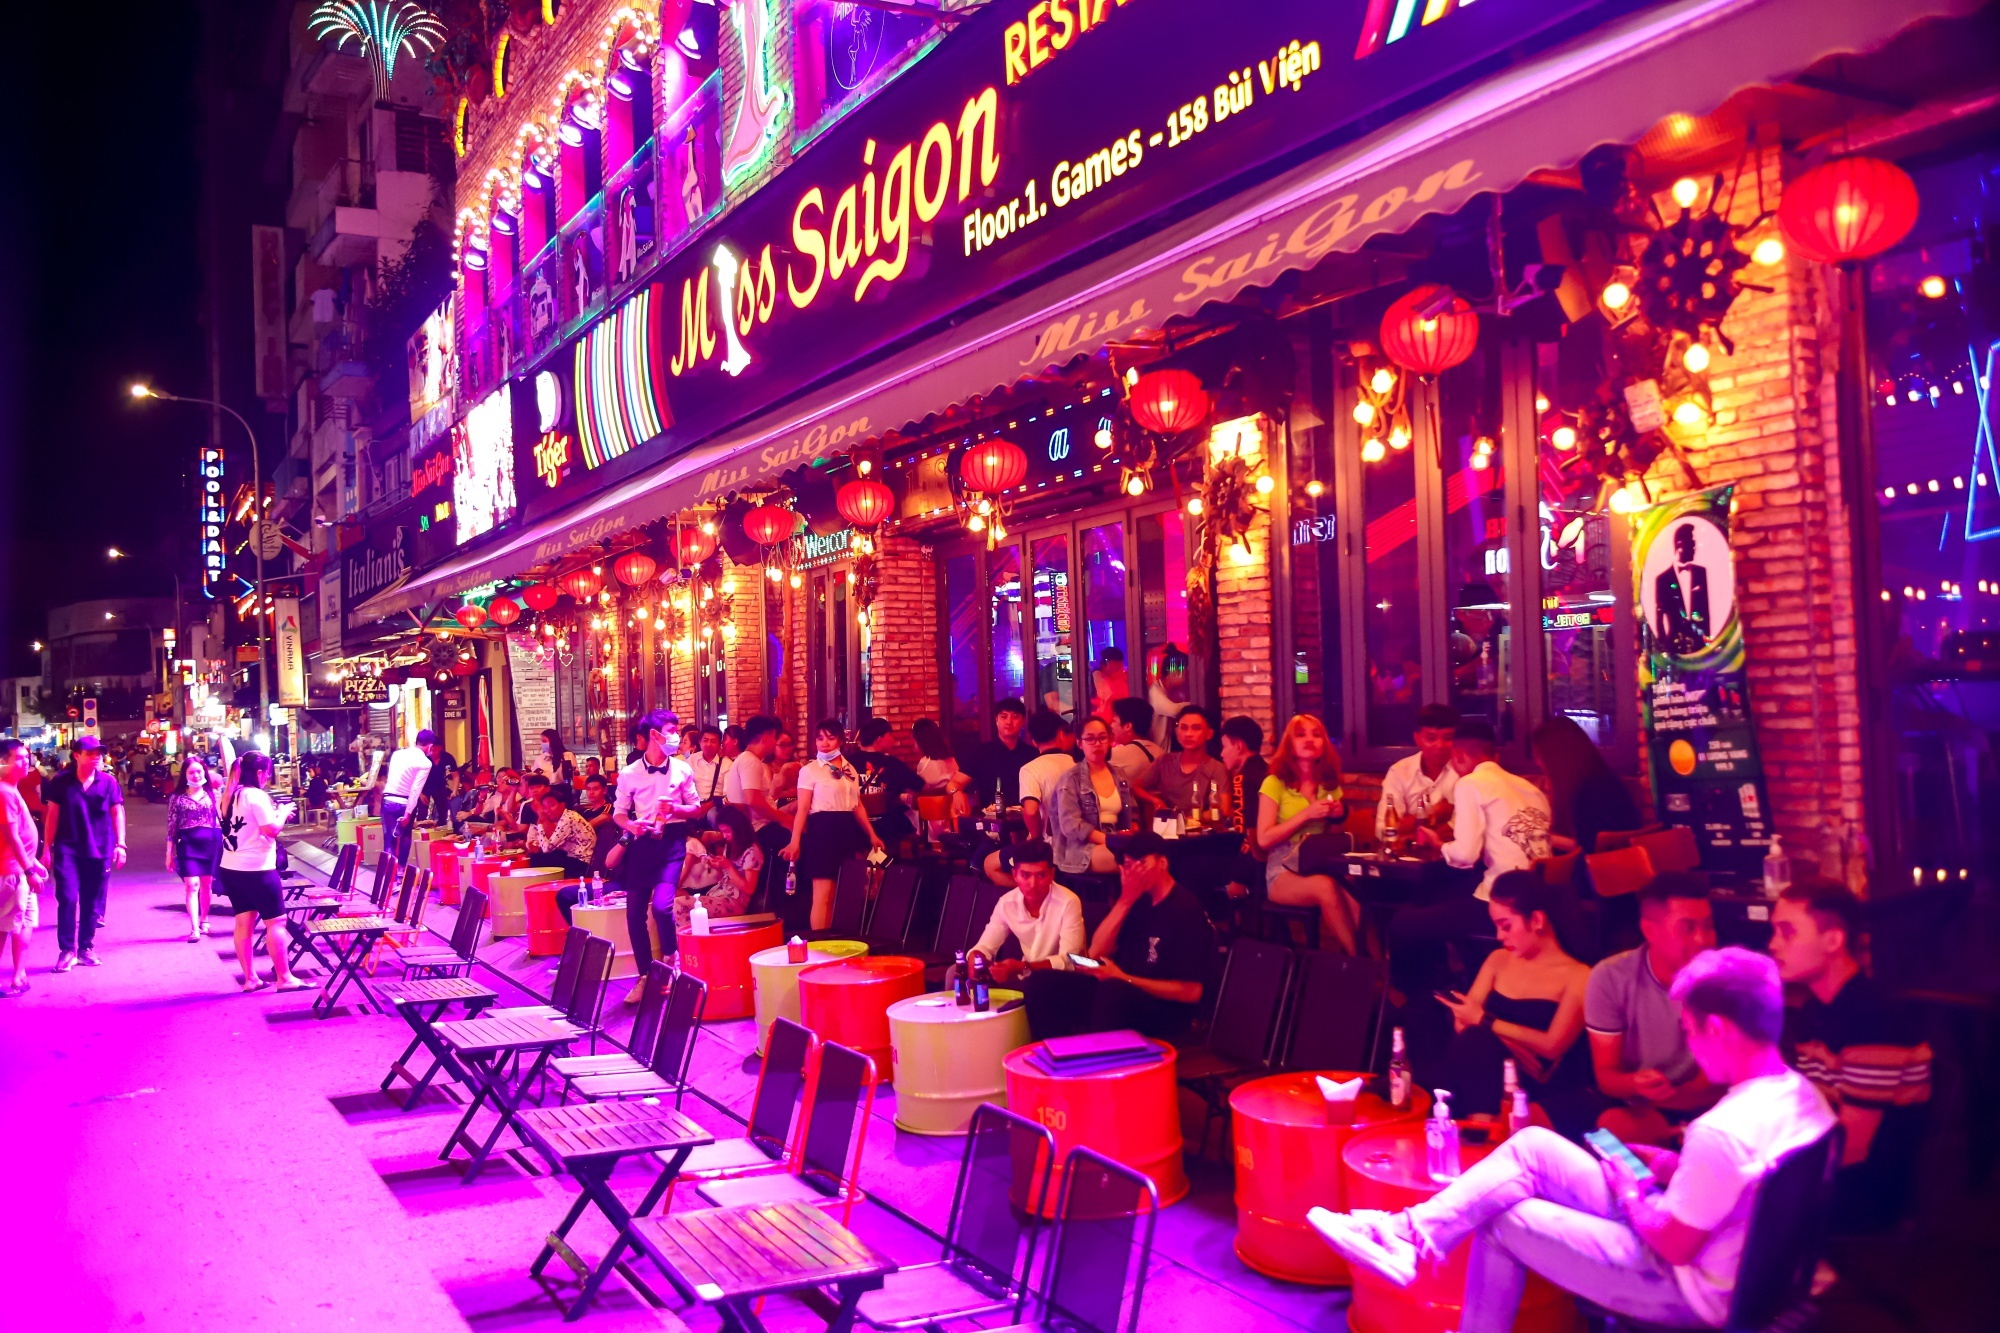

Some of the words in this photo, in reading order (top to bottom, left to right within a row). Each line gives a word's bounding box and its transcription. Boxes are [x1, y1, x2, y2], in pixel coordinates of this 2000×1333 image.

[1051, 129, 1143, 208] Games
[1166, 96, 1209, 147] 158
[1213, 67, 1254, 122] Bùi
[1258, 39, 1321, 95] Viện
[786, 85, 1000, 309] Saigon
[1020, 298, 1152, 366] Miss
[1173, 159, 1483, 303] SaiGon
[533, 430, 571, 488] Tiger
[694, 466, 751, 498] Miss
[758, 416, 872, 473] SaiGon
[206, 451, 221, 582] POOL&DART
[532, 542, 563, 562] Miss
[567, 516, 626, 548] SaiGon
[344, 679, 387, 692] PIZZA
[684, 954, 699, 968] 153
[1036, 1106, 1067, 1131] 150
